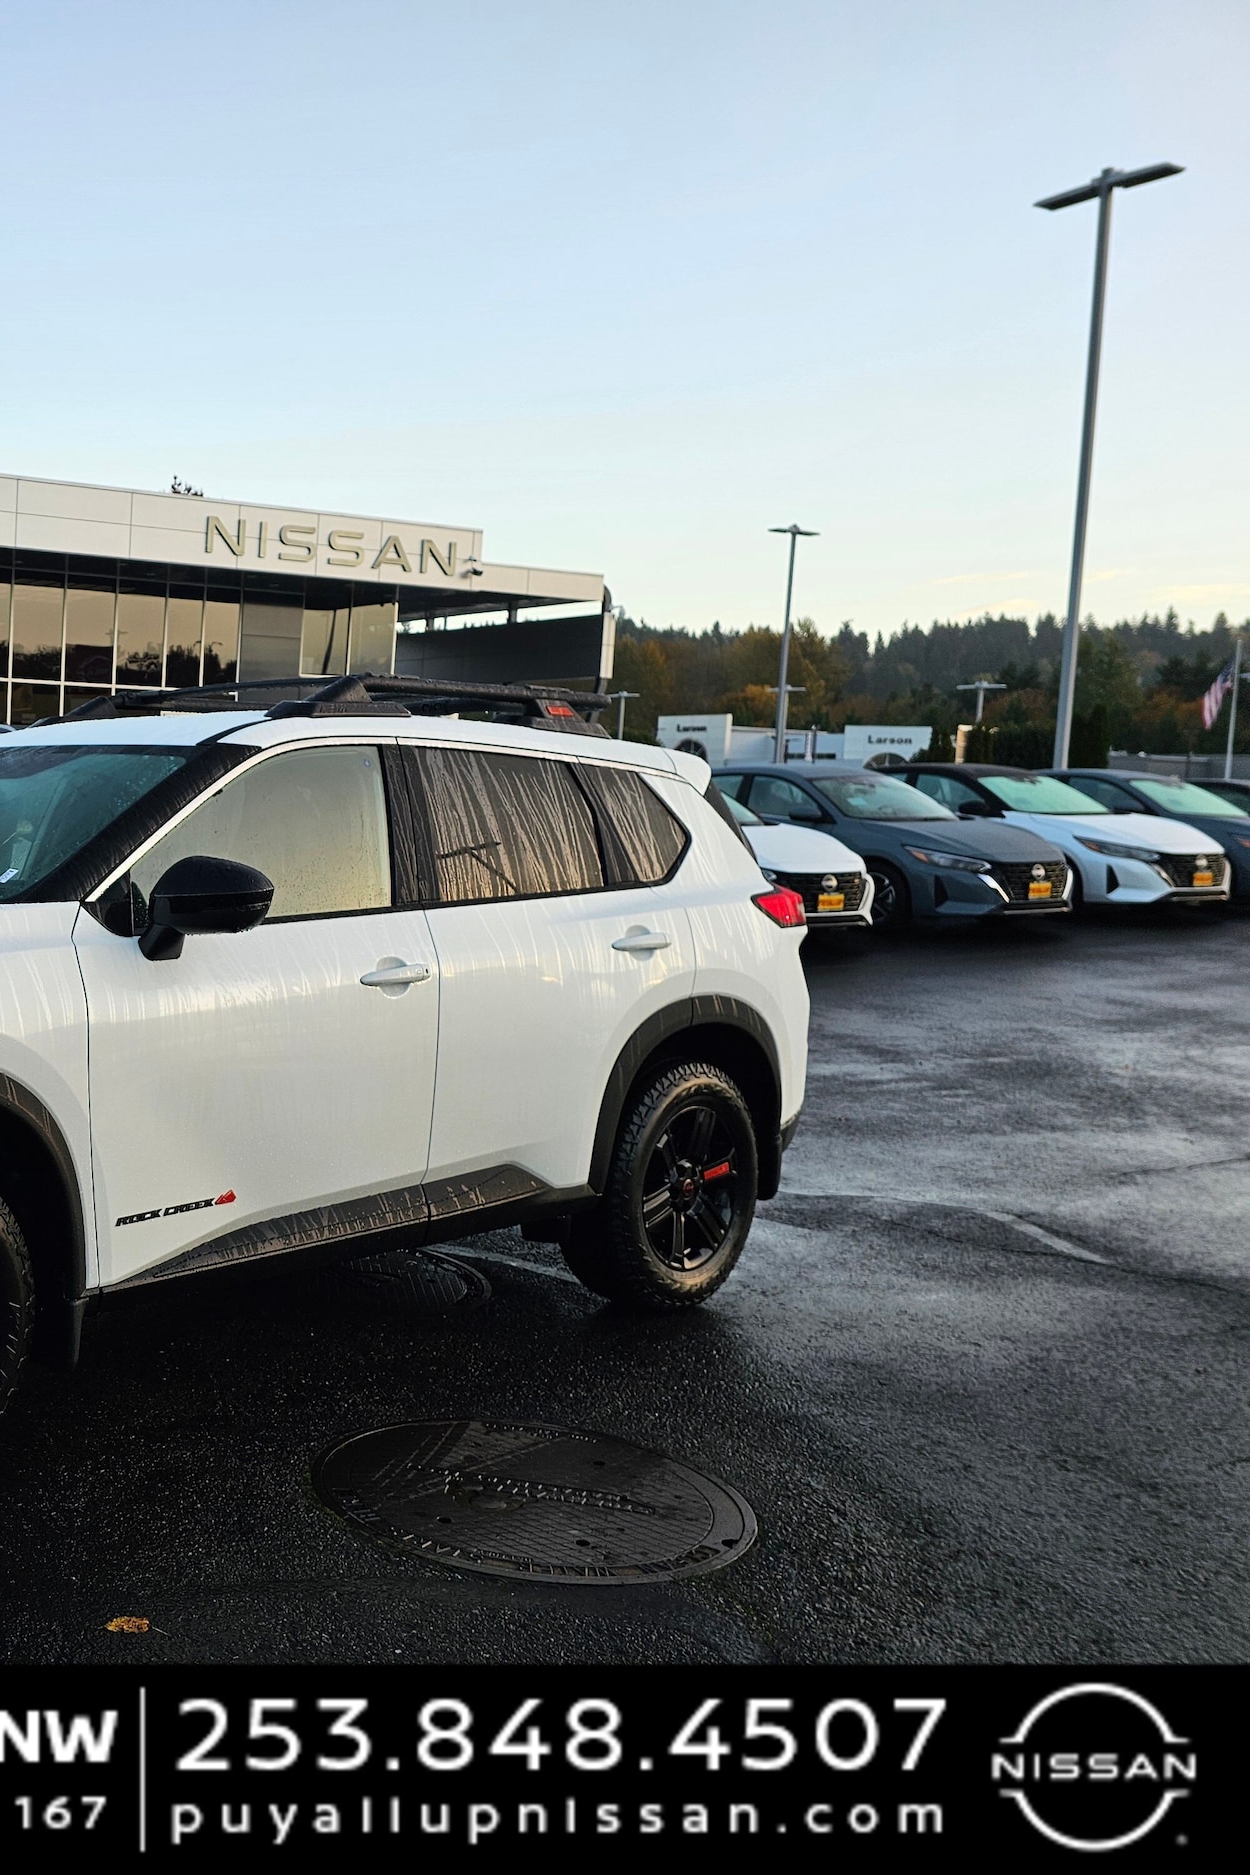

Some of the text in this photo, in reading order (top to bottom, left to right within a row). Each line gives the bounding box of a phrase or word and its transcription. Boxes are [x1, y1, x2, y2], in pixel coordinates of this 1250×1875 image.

[205, 515, 458, 577] NISSAN
[867, 733, 913, 745] Larson
[115, 1197, 216, 1227] ROCK CREEK
